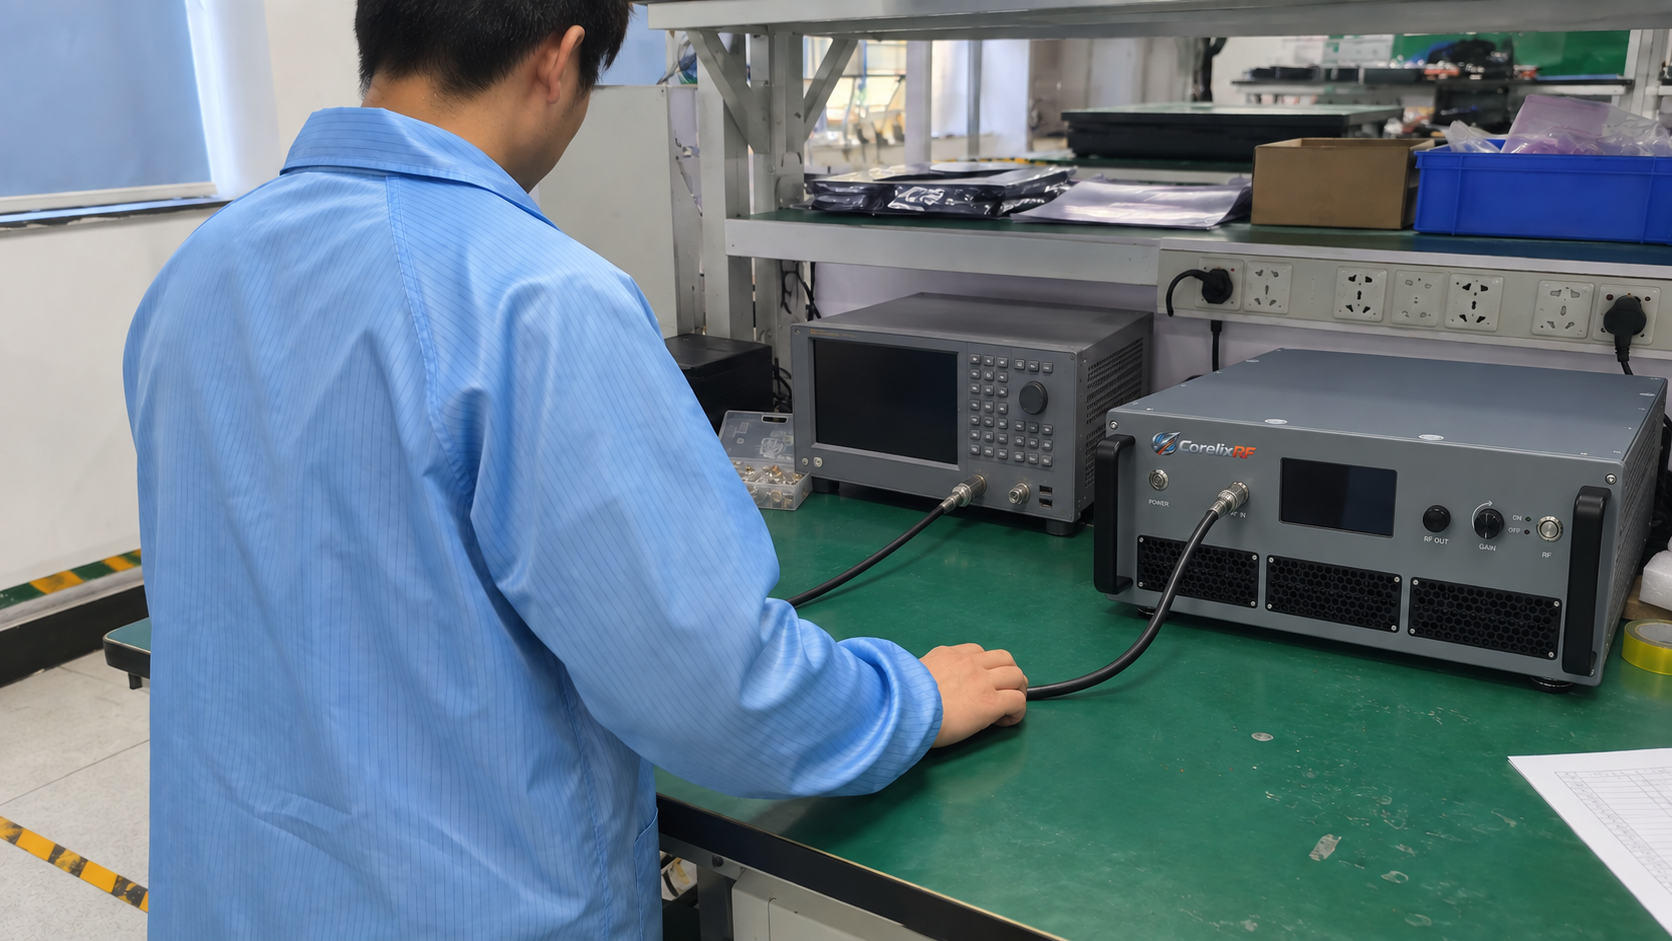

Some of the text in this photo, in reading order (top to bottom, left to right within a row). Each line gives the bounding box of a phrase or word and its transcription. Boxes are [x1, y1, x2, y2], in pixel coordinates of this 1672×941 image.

[1179, 440, 1257, 459] CorelixRF
[1148, 499, 1170, 507] POWER
[1434, 537, 1449, 545] OUT
[1478, 543, 1497, 551] GAIN
